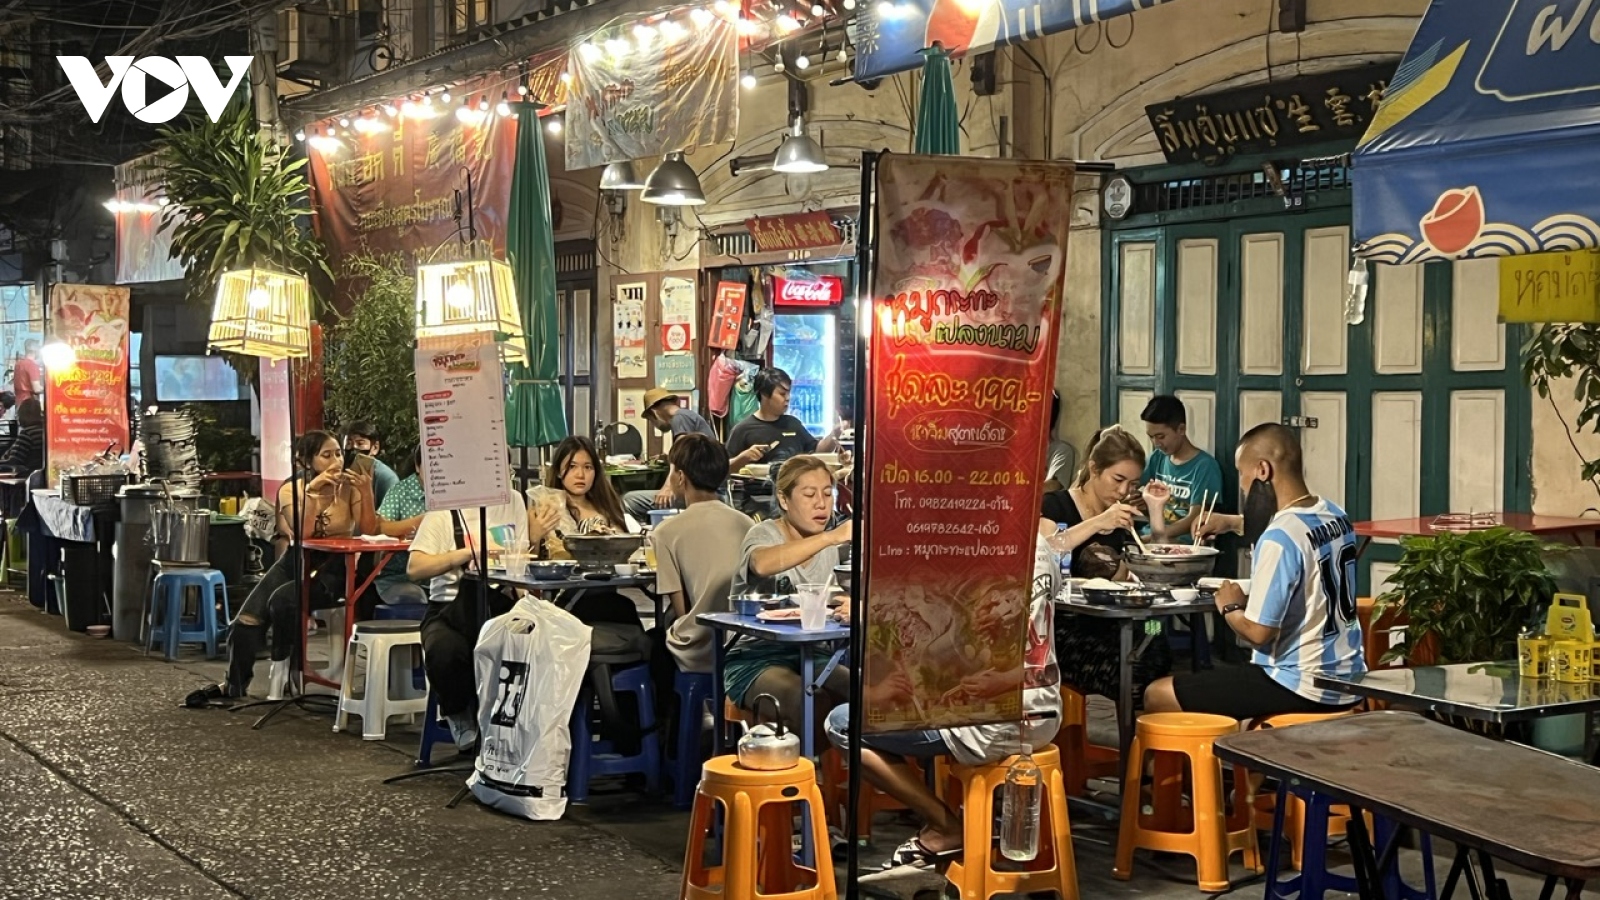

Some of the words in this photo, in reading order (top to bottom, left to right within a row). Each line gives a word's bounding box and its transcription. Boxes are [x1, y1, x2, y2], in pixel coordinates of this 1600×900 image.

[782, 279, 835, 301] Coca-Cola
[880, 460, 909, 483] เปิด
[915, 470, 952, 484] 16.00
[969, 471, 1010, 486] 22.00
[1319, 541, 1356, 637] 10
